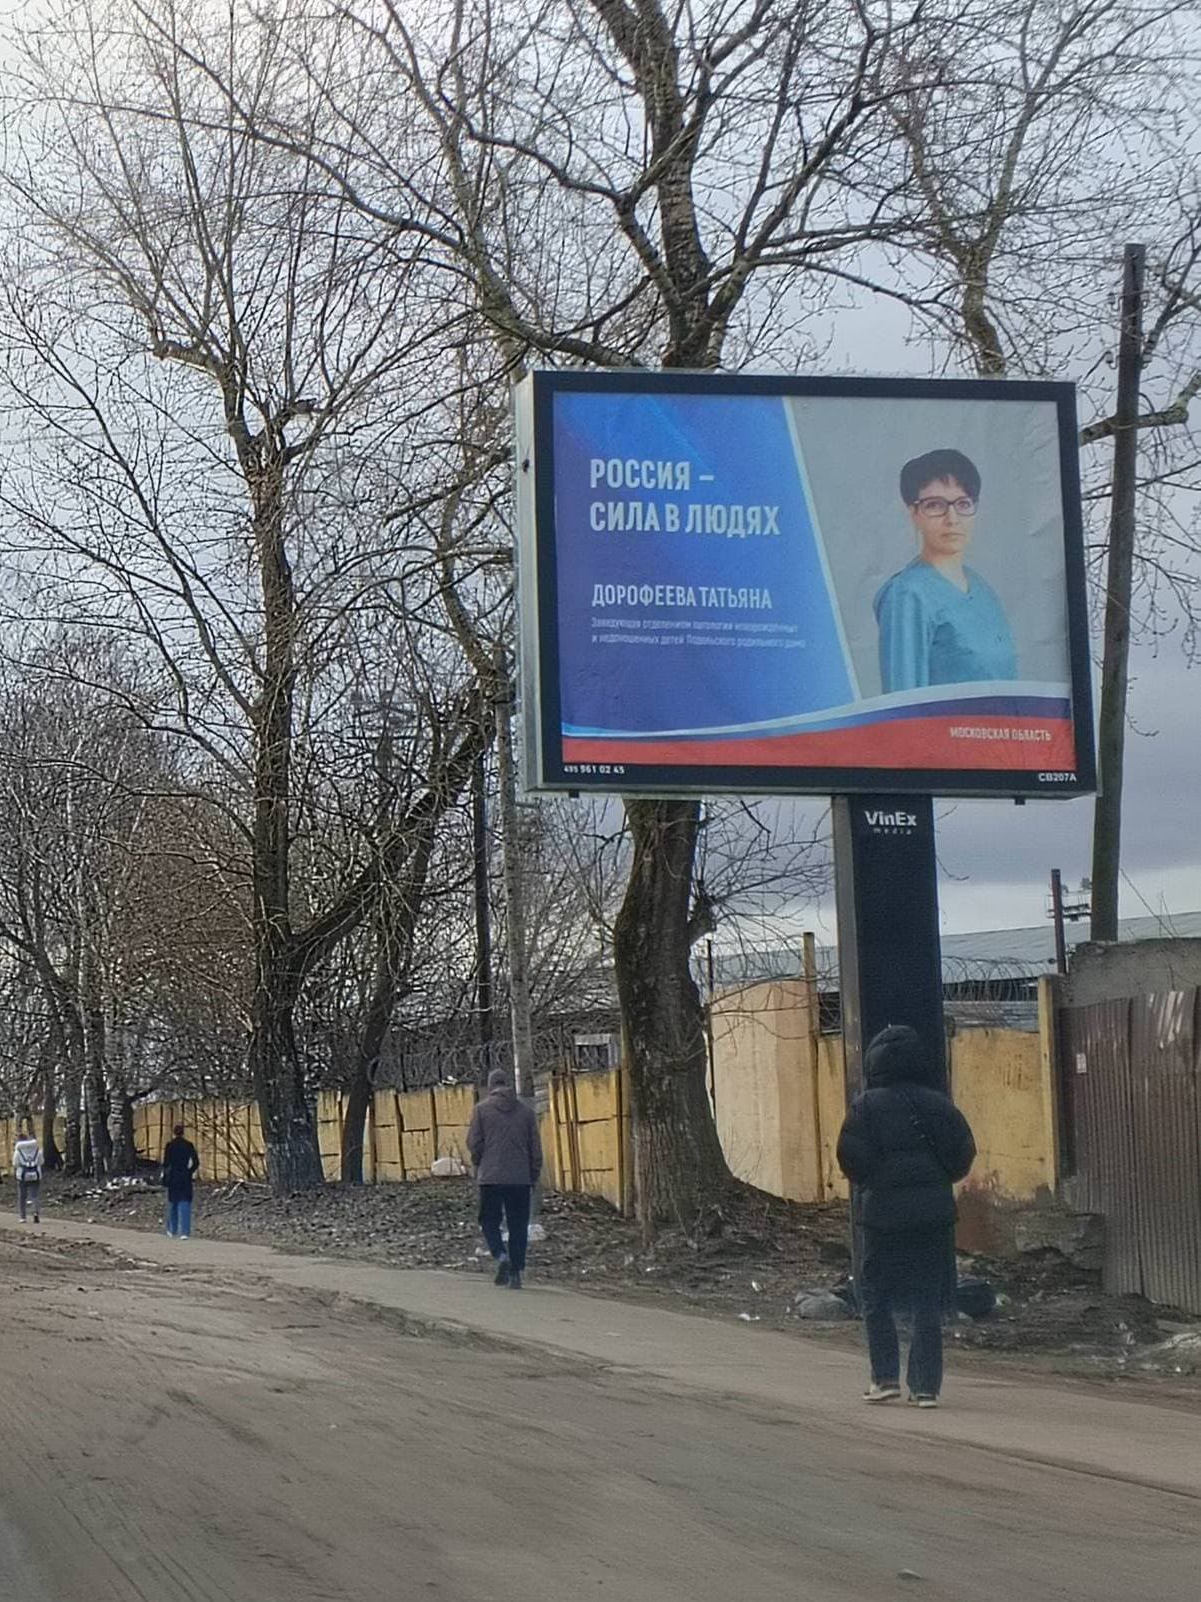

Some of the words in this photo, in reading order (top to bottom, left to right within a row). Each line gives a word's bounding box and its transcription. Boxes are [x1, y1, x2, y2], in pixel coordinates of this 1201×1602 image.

[590, 458, 691, 491] РОССИЯ
[589, 501, 660, 532] СИЛА
[665, 503, 680, 532] В
[685, 503, 780, 538] ЛЮДЯХ
[591, 583, 696, 607] ДОРОФЕЕВА
[698, 586, 773, 609] ТАТЬЯНА
[950, 727, 1010, 740] МОСКОВСКАЯ
[1012, 729, 1052, 741] ОБЛАСТЬ
[864, 811, 917, 826] VinEx
